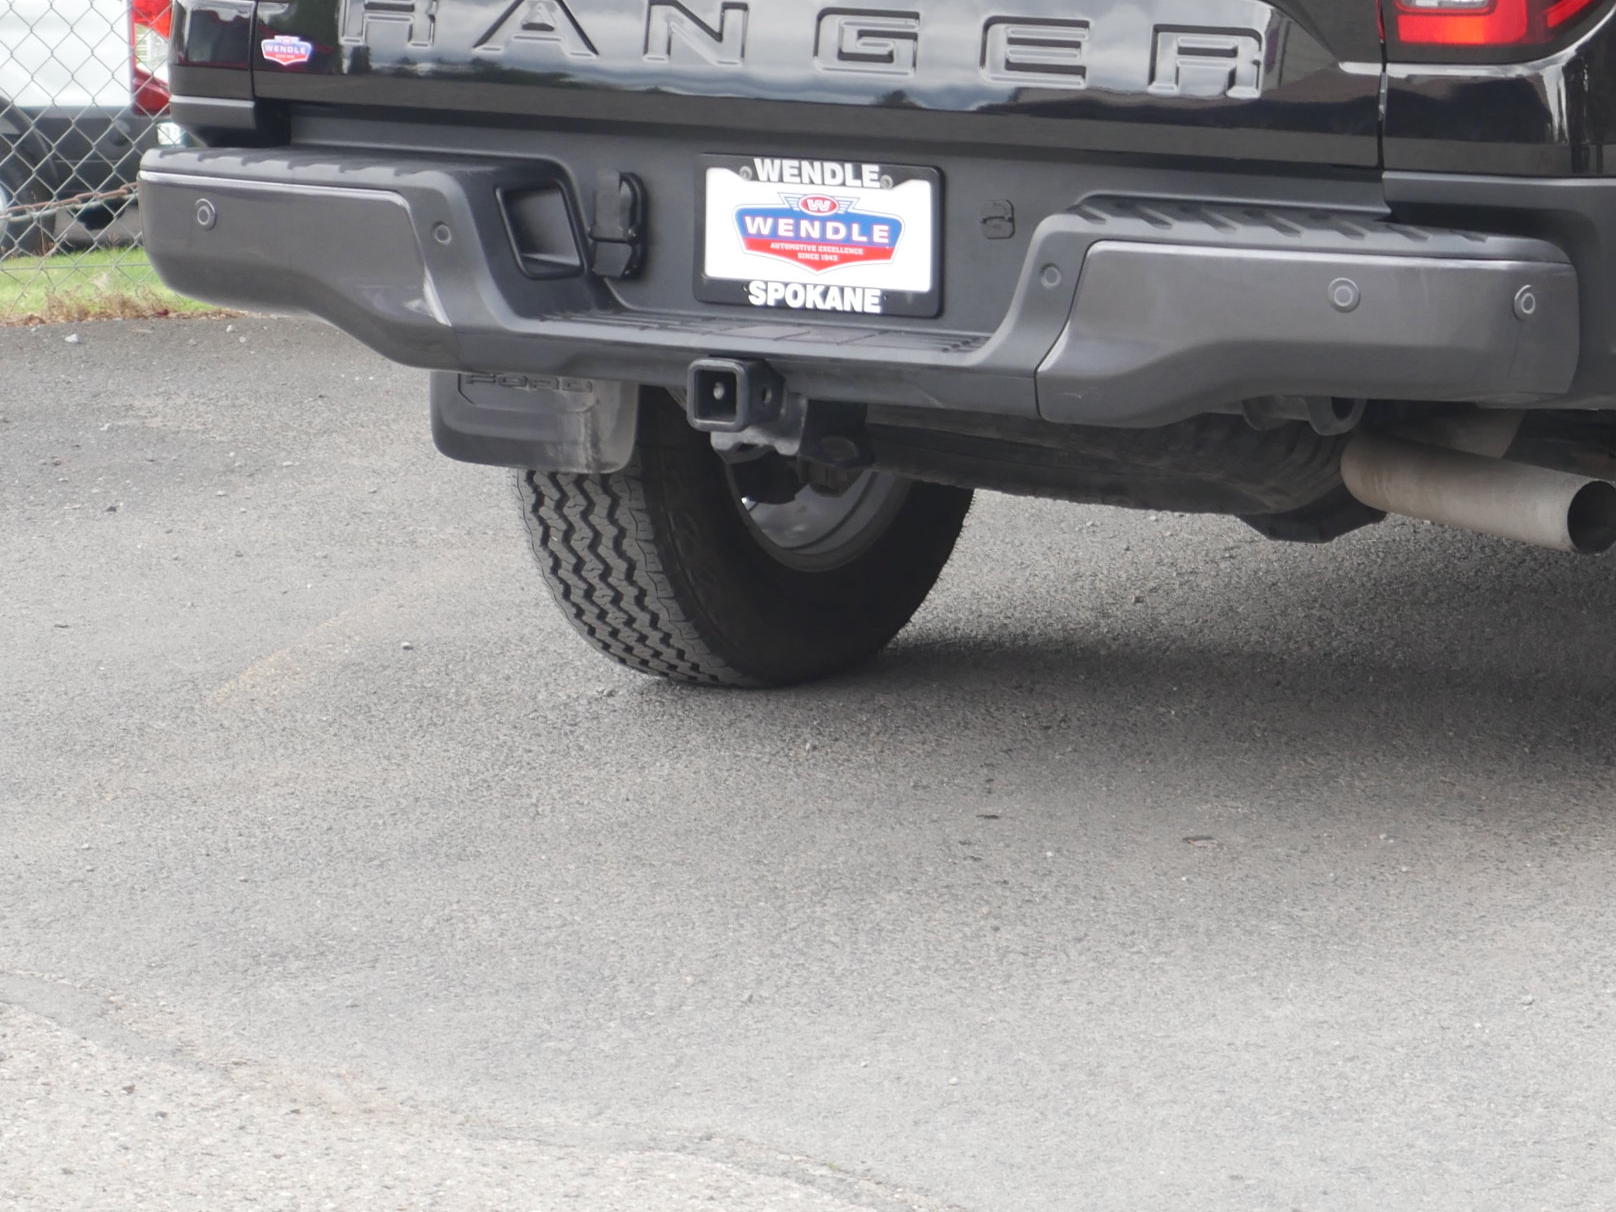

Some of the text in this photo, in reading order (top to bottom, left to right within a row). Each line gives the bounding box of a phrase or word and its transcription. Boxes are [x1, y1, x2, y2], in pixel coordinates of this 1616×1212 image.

[265, 44, 306, 54] WENDLE
[753, 157, 882, 189] WENDLE
[806, 198, 831, 213] W
[744, 215, 890, 244] WENDLE
[769, 241, 864, 256] AUTOMOTIVE EXCELLENCE
[797, 252, 839, 262] SINCE 1943
[748, 280, 882, 314] SPOKANE
